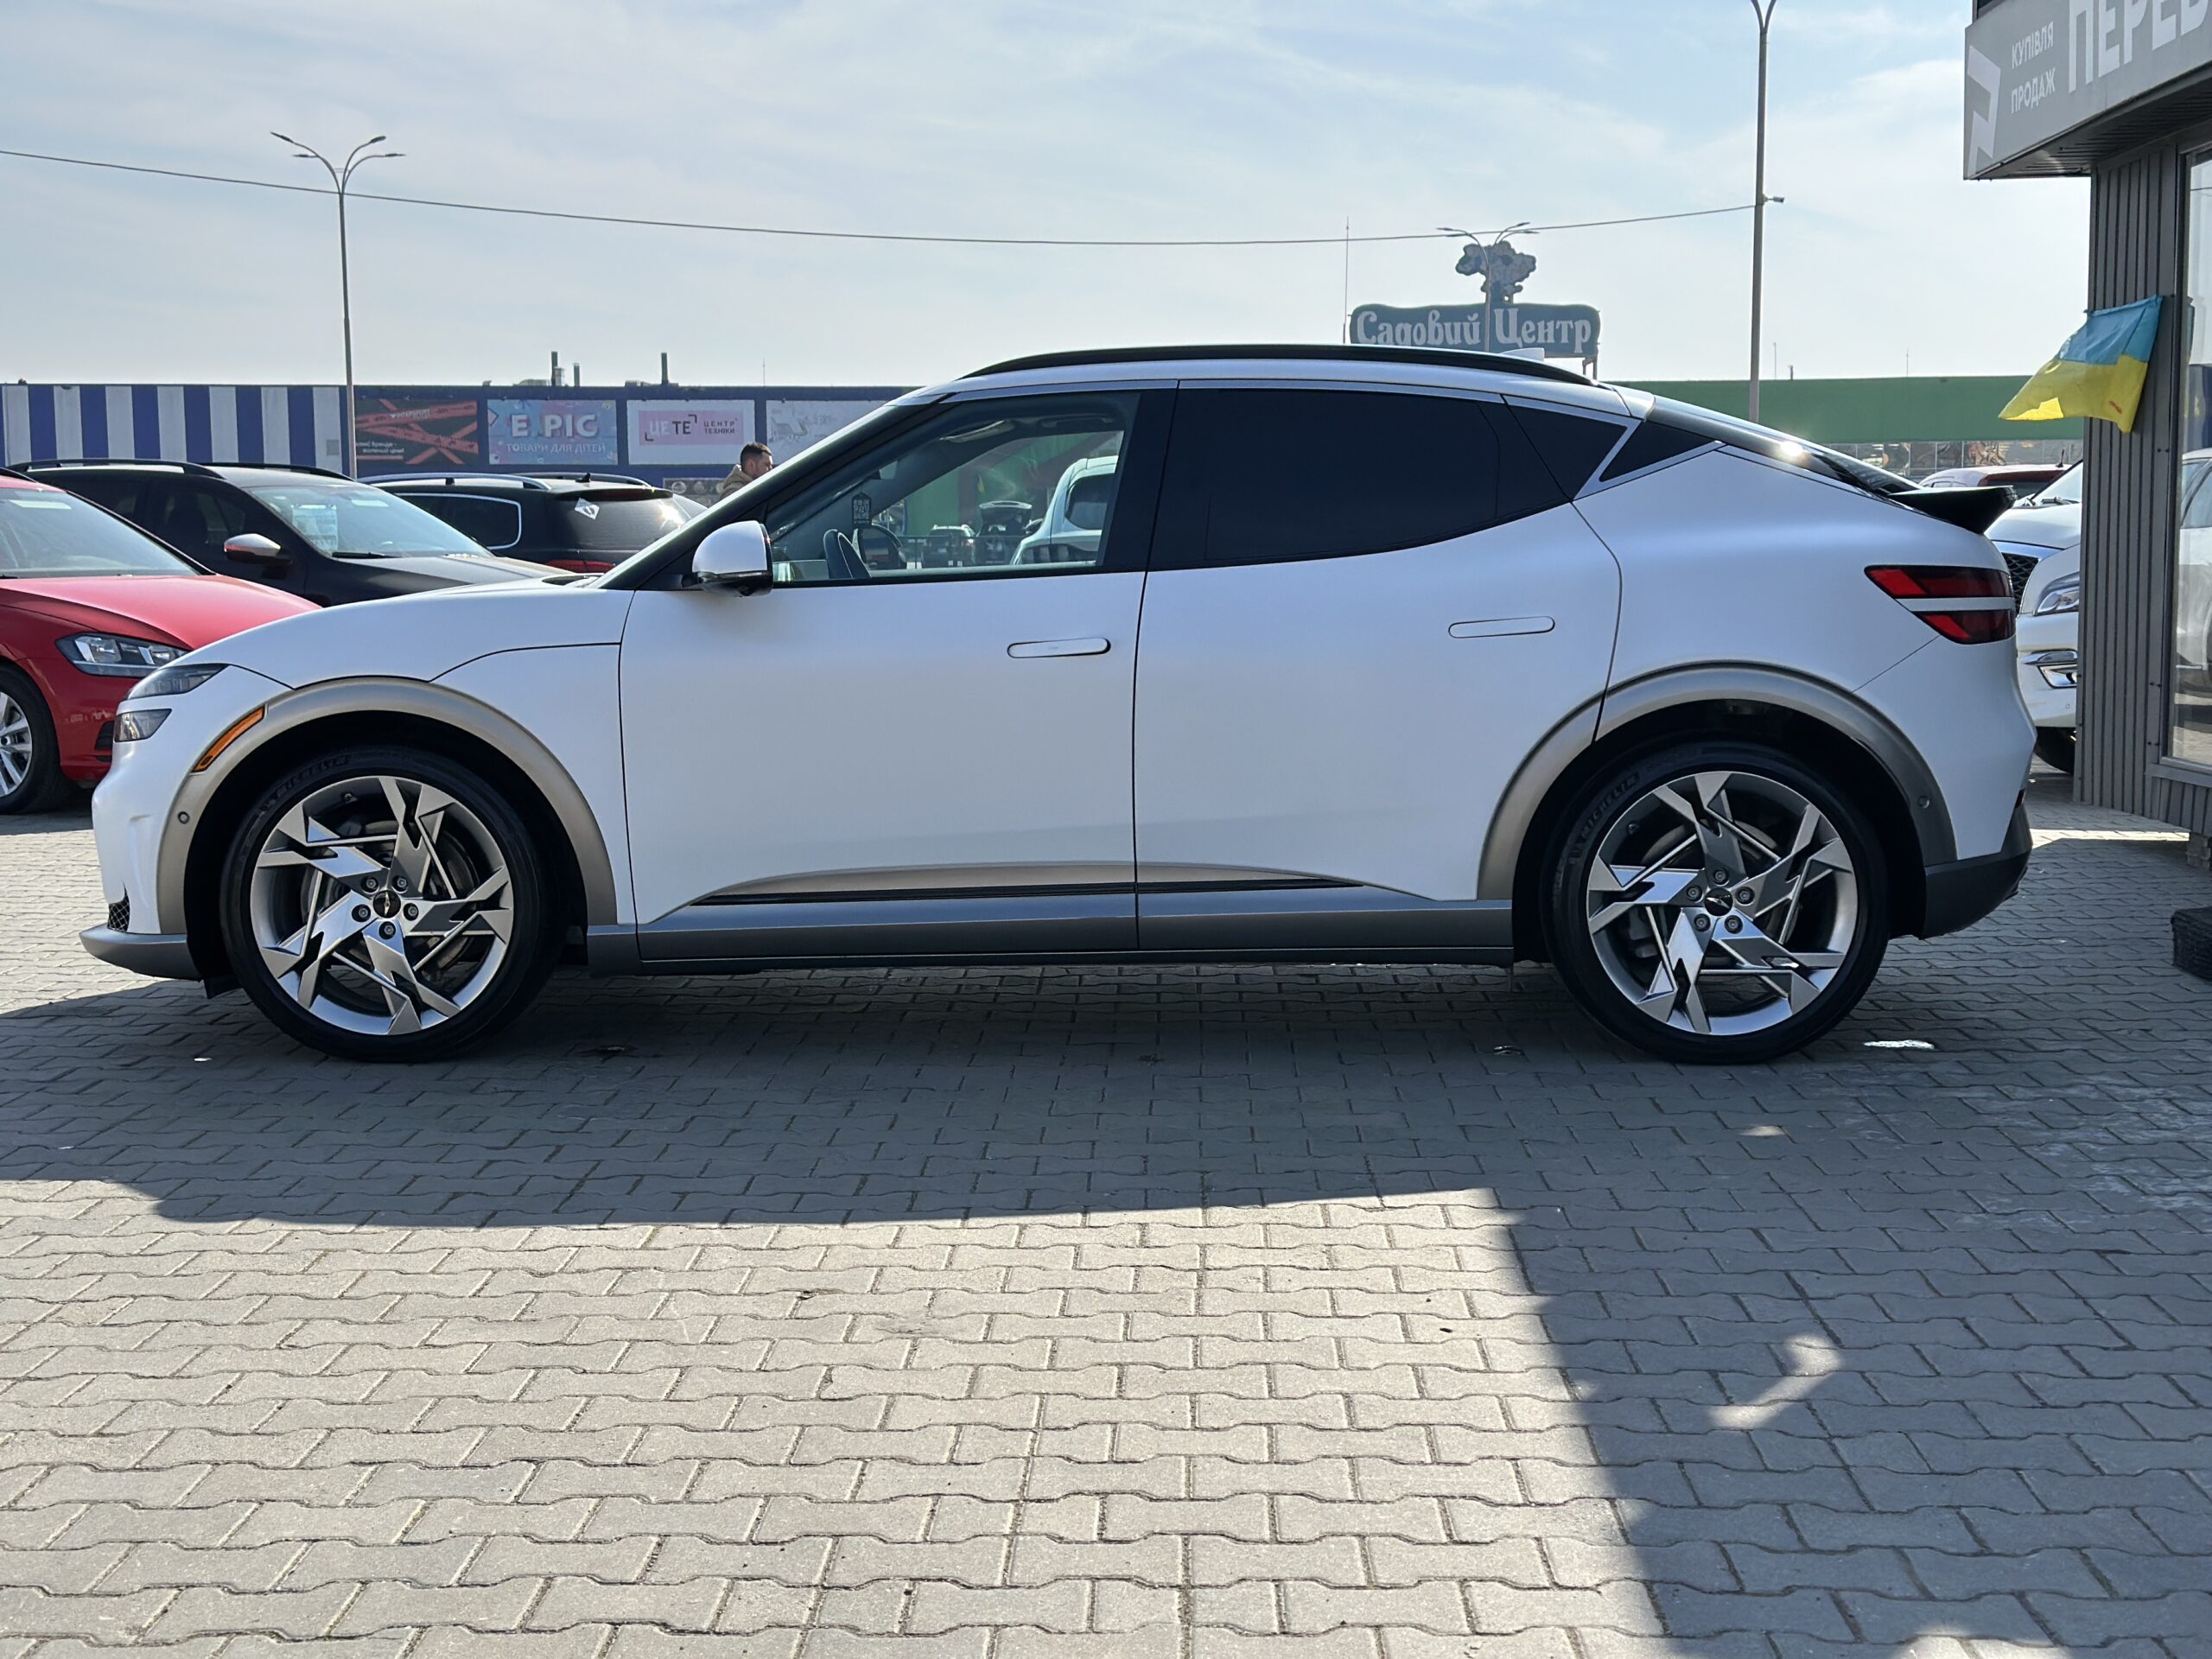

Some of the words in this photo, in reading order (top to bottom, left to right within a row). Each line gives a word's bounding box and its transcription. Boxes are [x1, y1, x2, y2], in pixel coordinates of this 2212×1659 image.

[2012, 21, 2054, 69] КУПІВЛЯ
[2011, 67, 2056, 113] ПРОДАЖ
[1356, 309, 1481, 346] Садовий
[1493, 308, 1592, 353] Центр
[506, 442, 548, 453] ТОВАРИ
[550, 442, 572, 454] ДЛЯ
[575, 442, 606, 454] ДІТЕЙ
